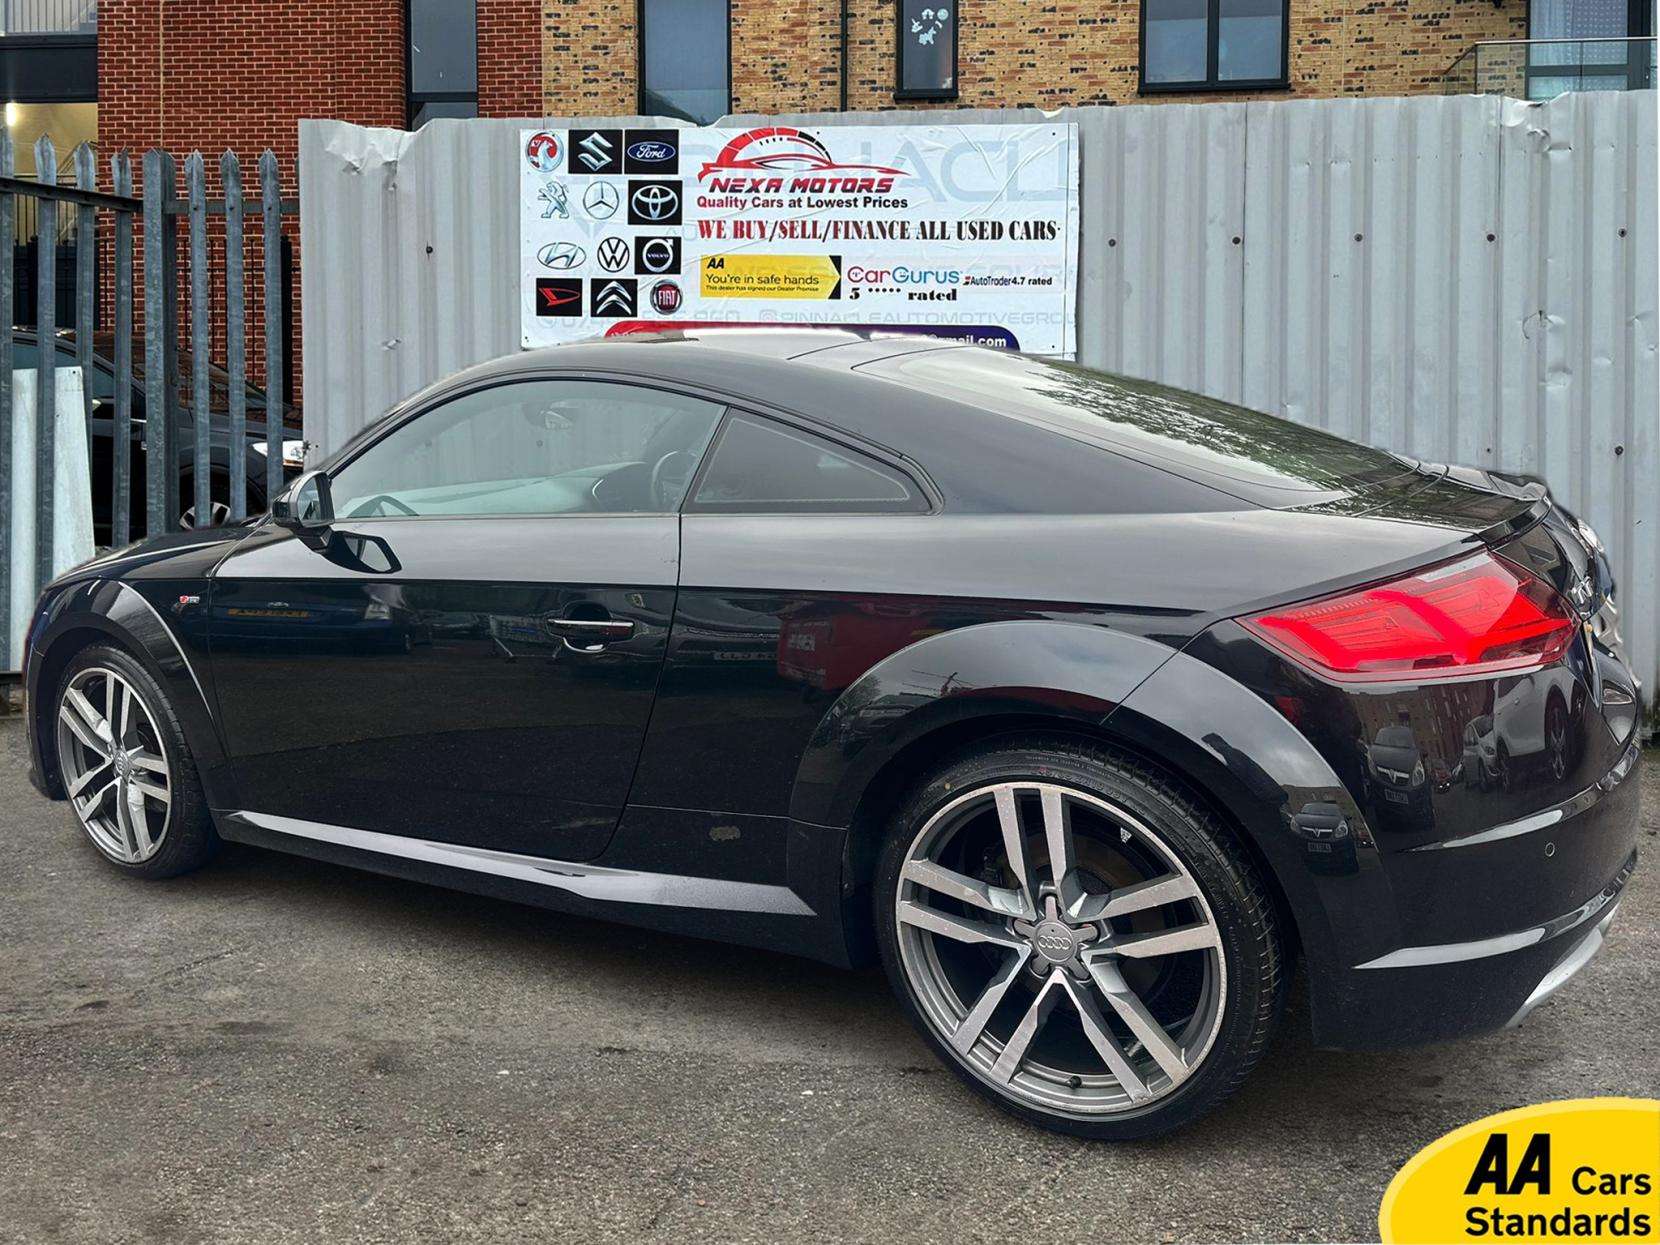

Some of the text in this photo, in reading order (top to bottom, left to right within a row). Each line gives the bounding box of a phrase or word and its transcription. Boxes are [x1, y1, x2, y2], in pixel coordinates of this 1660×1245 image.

[636, 144, 667, 158] Ford
[708, 178, 894, 194] NEXA MOTORS
[696, 196, 908, 210] Quality Cars at Lowest Prices
[697, 219, 727, 239] WE
[917, 220, 951, 240] ALL
[956, 220, 1004, 240] USED
[1008, 220, 1057, 240] CARS
[707, 258, 724, 269] AA
[706, 274, 820, 285] You're in safe hands
[847, 266, 960, 284] CarGurus
[1028, 277, 1053, 285] rated
[658, 290, 676, 305] FIAT
[849, 288, 957, 301] 5 rated
